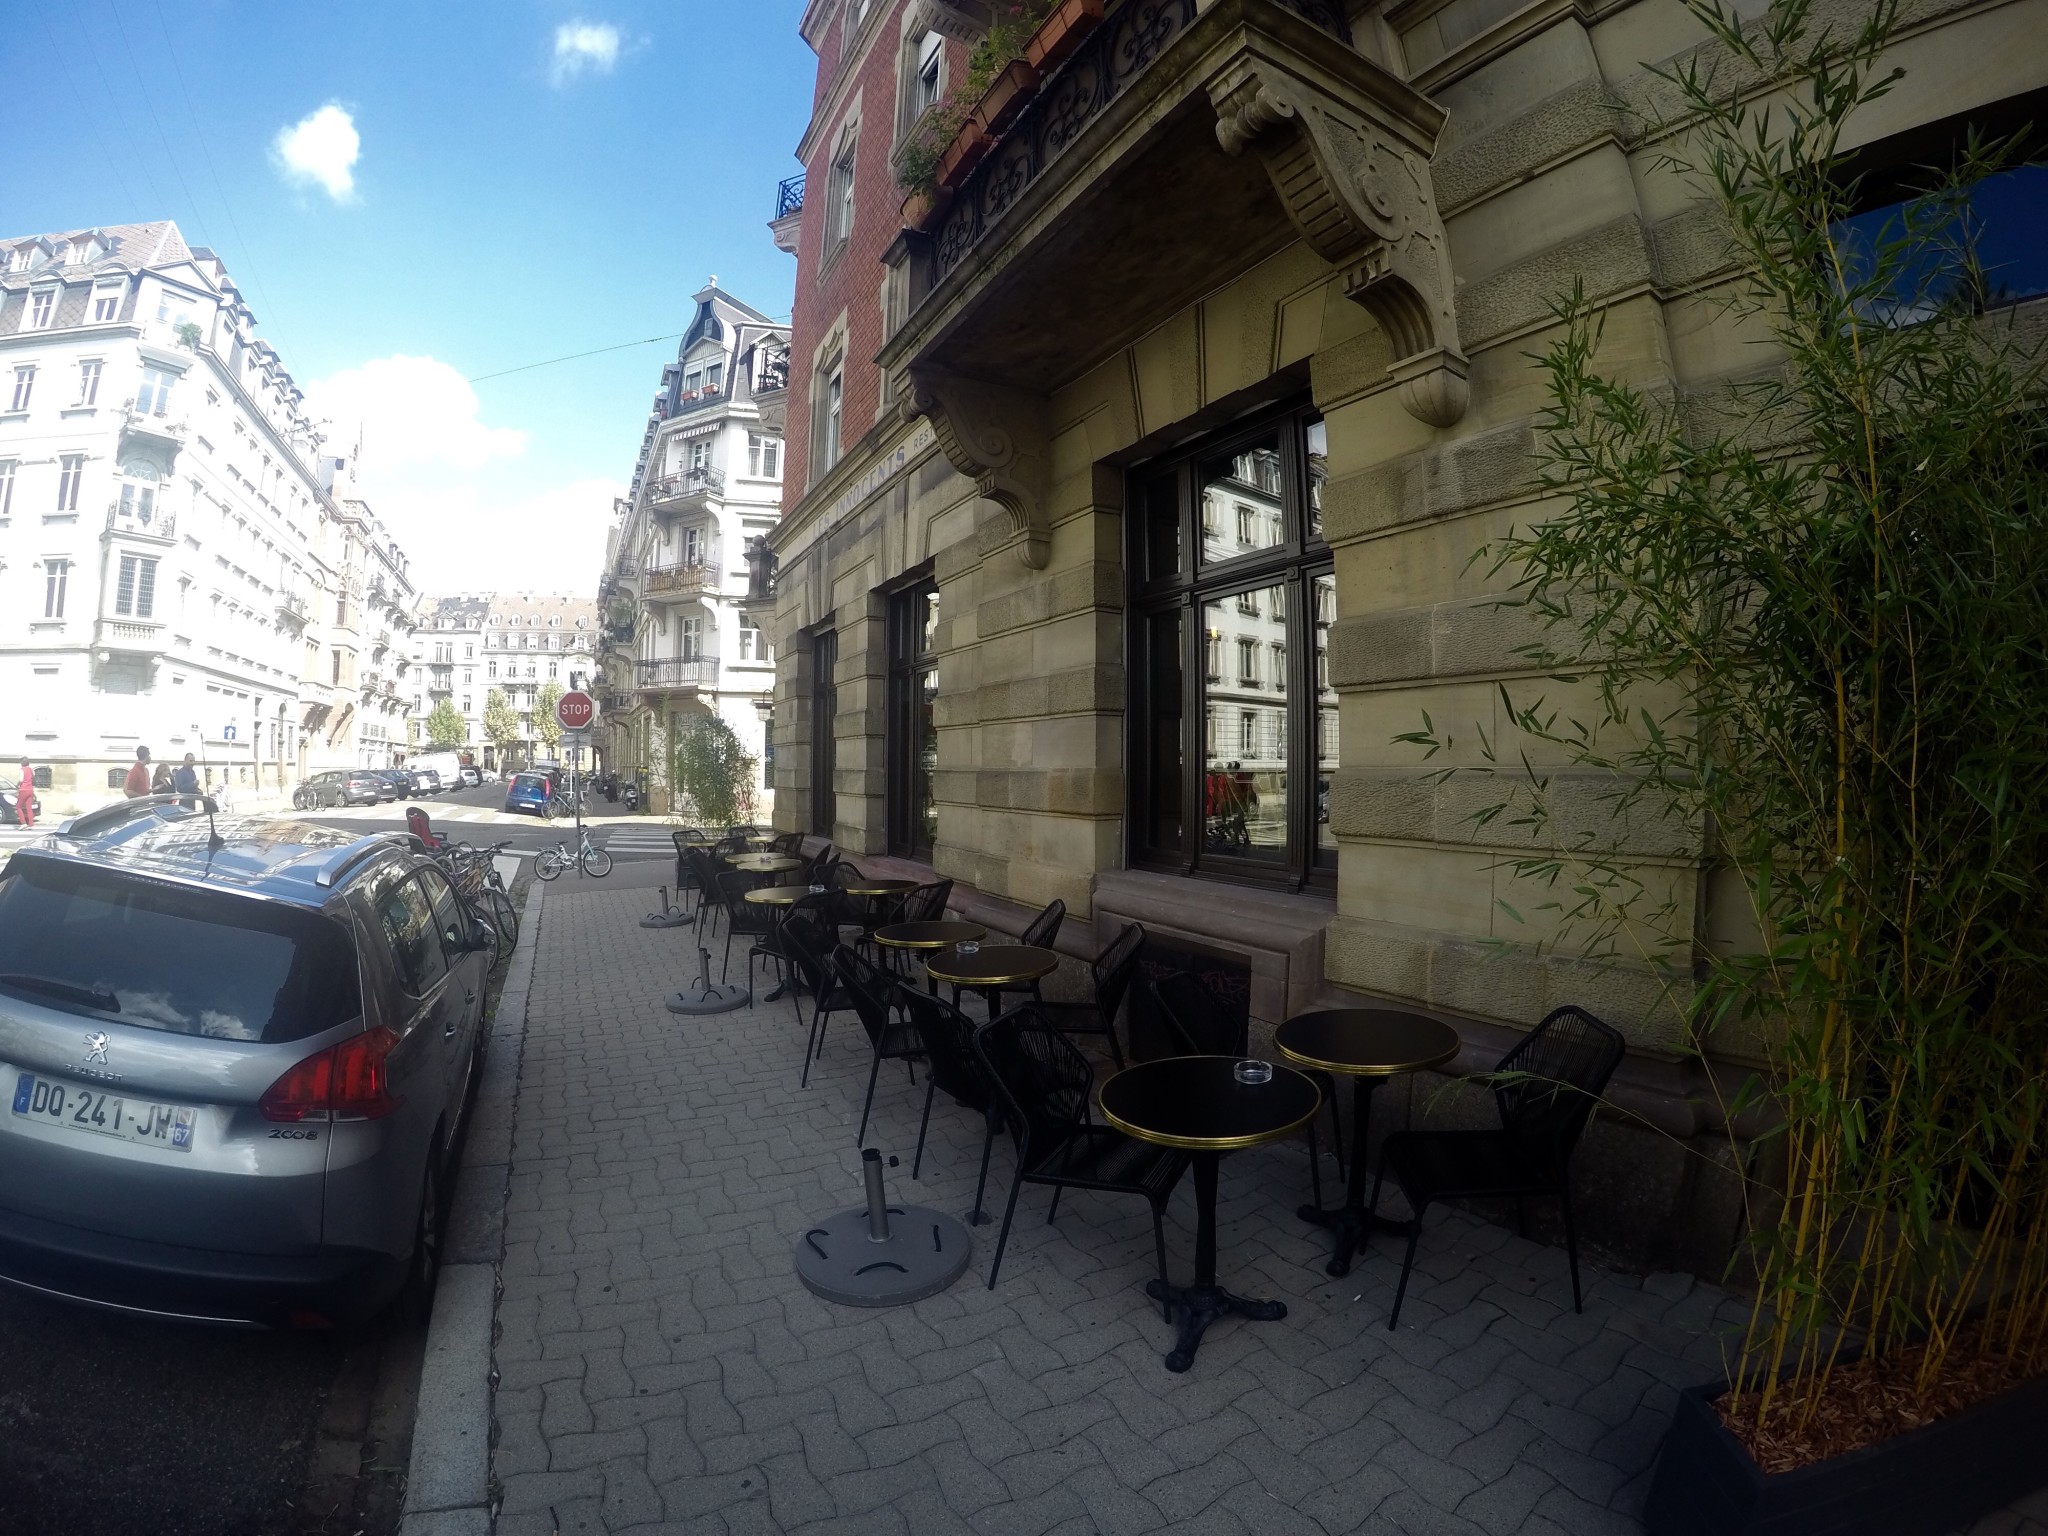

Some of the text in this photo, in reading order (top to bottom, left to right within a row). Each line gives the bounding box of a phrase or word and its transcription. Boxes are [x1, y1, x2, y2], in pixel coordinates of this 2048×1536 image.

[836, 445, 905, 522] INNOCENTS
[562, 704, 590, 715] STOP
[65, 1063, 123, 1081] PEUGEOT
[174, 1127, 190, 1143] 67
[268, 1129, 318, 1141] 2008
